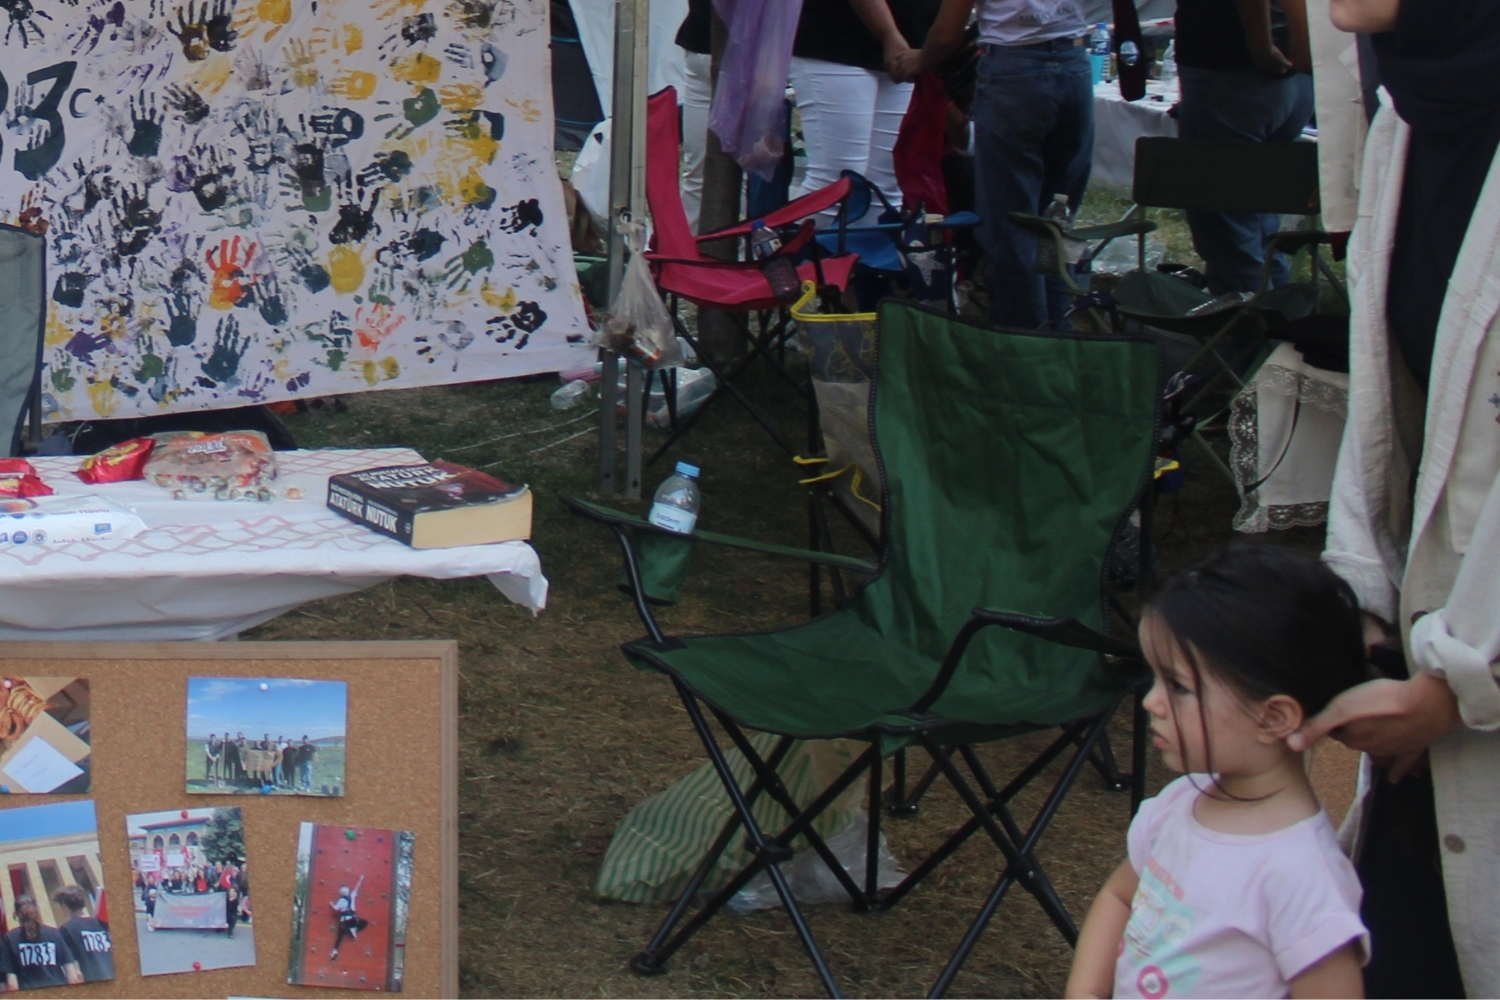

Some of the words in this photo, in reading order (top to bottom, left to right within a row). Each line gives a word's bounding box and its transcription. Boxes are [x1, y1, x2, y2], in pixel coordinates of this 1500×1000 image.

[366, 472, 457, 489] NUTUK
[329, 490, 363, 518] ATATÜRK
[366, 505, 398, 533] NUTUK
[19, 942, 51, 966] 1283
